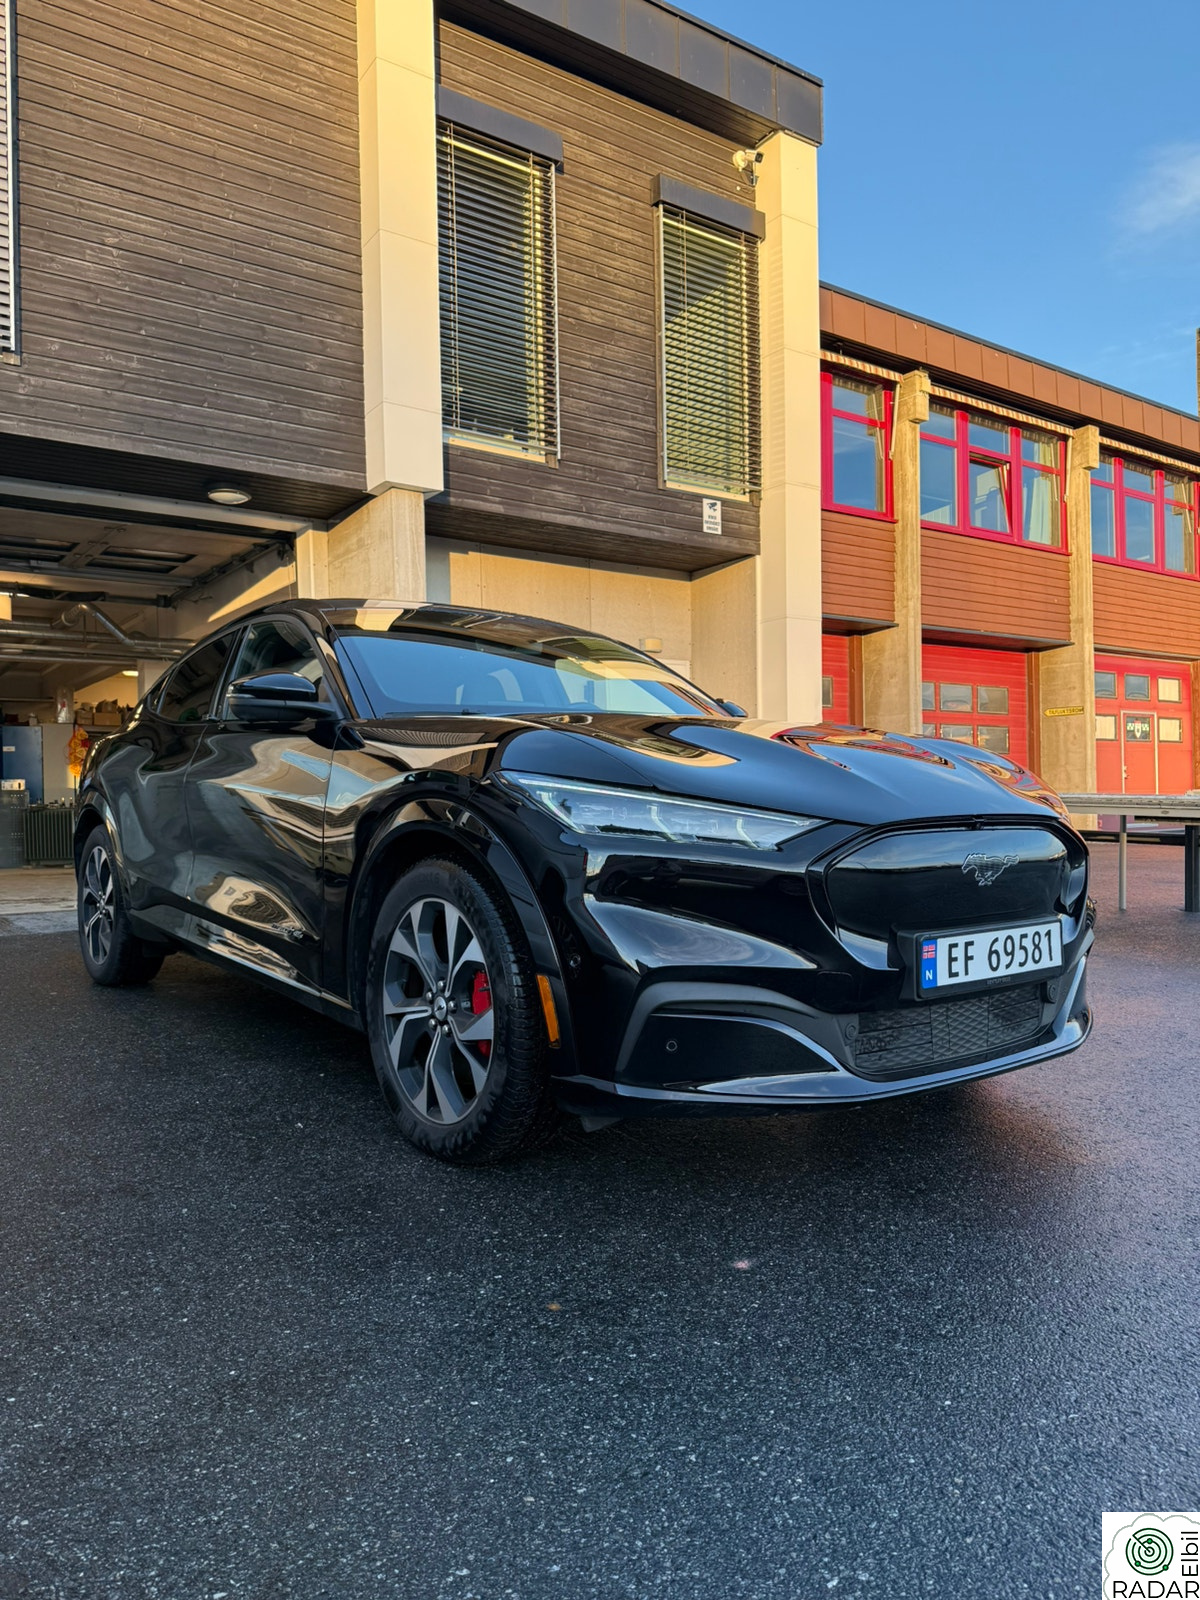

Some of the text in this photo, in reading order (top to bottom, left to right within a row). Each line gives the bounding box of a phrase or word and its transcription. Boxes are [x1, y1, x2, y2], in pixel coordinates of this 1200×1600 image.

[948, 929, 1053, 978] EF 69581
[925, 969, 933, 981] N
